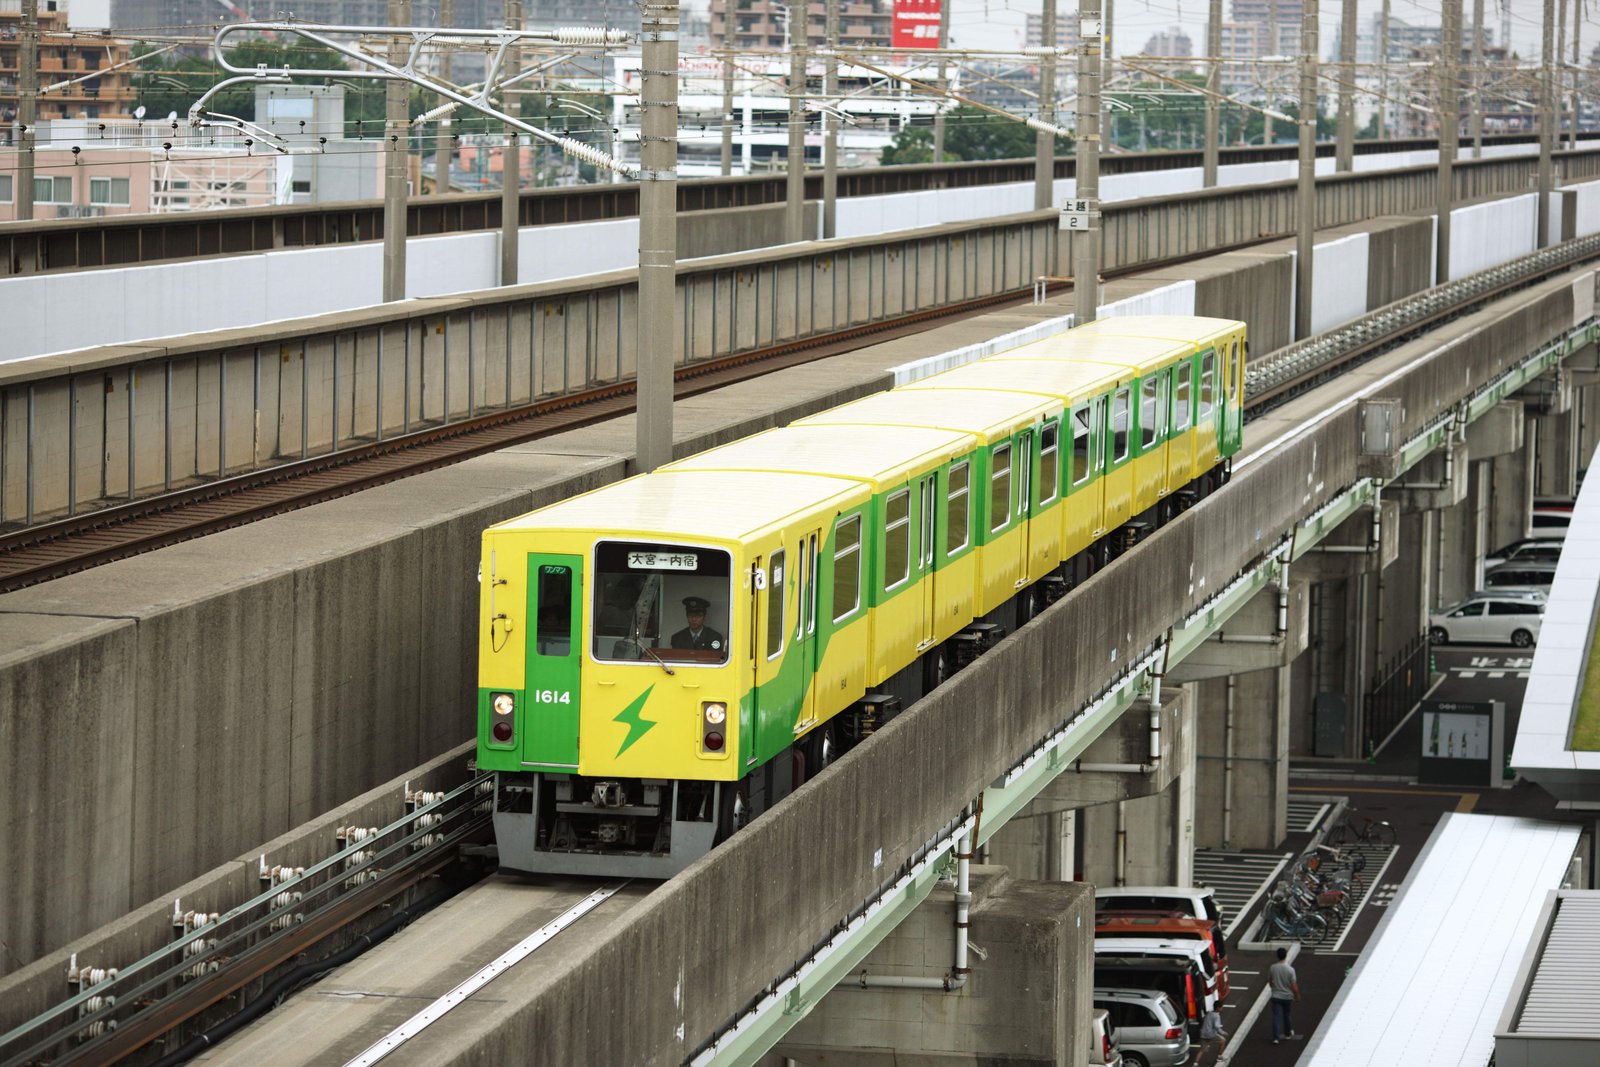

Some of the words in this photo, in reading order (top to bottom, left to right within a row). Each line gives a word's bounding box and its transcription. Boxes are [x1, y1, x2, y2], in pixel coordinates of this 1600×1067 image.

[1063, 200, 1086, 212] 上越
[1070, 217, 1078, 228] 2
[545, 566, 566, 574] ワンマン
[535, 689, 571, 705] 1614
